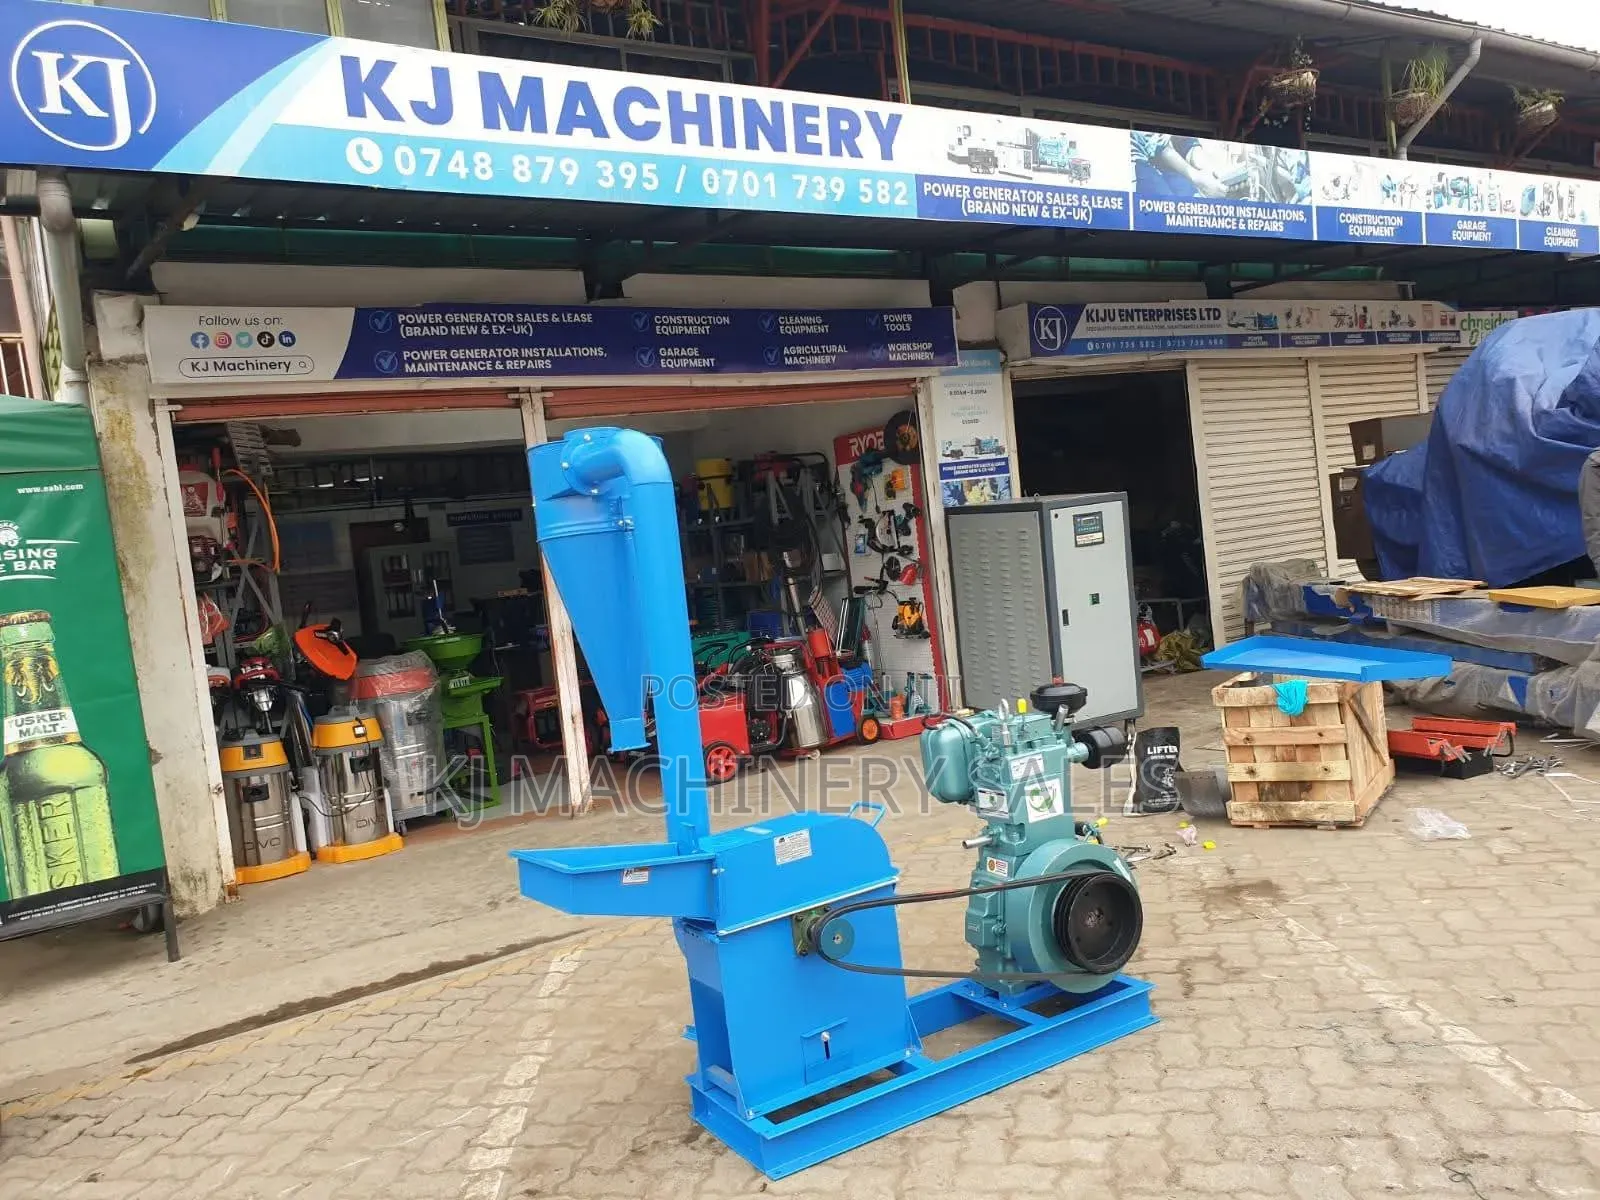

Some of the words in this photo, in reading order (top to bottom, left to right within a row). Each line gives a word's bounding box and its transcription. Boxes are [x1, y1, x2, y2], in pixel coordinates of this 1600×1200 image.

[31, 50, 131, 156] KJ
[340, 55, 454, 125] KJ
[478, 71, 903, 161] MACHINERY
[394, 145, 494, 181] 0748
[512, 154, 580, 186] 879
[596, 159, 660, 192] 395
[674, 164, 687, 194] /
[702, 167, 777, 199] 0701
[792, 174, 845, 204] 739
[858, 178, 908, 206] 582
[923, 182, 971, 199] POWER
[973, 186, 1044, 204] GENERATOR
[1046, 193, 1079, 207] SALES
[1081, 196, 1091, 207] &
[1092, 196, 1124, 210] LEASE
[961, 196, 1010, 217] (BRAND
[1012, 204, 1039, 217] NEW
[1041, 206, 1050, 217] &
[1053, 205, 1093, 224] EX-UK)
[1139, 200, 1175, 213] POWER
[1179, 202, 1235, 217] GENERATOR
[1236, 206, 1307, 223] INSTALLATIONS,
[1166, 214, 1237, 230] MAINTENANCE
[1239, 220, 1246, 230] &
[1247, 219, 1284, 232] REPAIRS
[1339, 213, 1404, 226] CONSTRUCTION
[1456, 220, 1487, 231] GARAGE
[1349, 225, 1395, 237] EQUIPMENT
[1452, 230, 1492, 242] EQUIPMENT
[1545, 227, 1577, 238] CLEANING
[1544, 236, 1579, 248] EQUIPMENT
[199, 315, 241, 326] Follow
[245, 316, 260, 326] us
[264, 315, 284, 326] on:
[398, 313, 444, 325] POWER
[445, 313, 514, 323] GENERATOR
[516, 313, 549, 323] SALES
[551, 313, 561, 323] &
[562, 313, 593, 323] LEASE
[654, 315, 730, 326] CONSTRUCTION
[778, 315, 823, 326] CLEANING
[883, 313, 913, 323] POWER
[1085, 308, 1116, 323] KIJU
[1119, 307, 1198, 323] ENTERPRISES
[1199, 307, 1222, 321] LTD
[400, 324, 449, 338] (BRAND
[451, 325, 478, 336] NEW
[480, 325, 490, 335] &
[492, 323, 533, 337] EX-UK)
[656, 325, 711, 335] EQUIPMENT
[780, 325, 829, 334] EQUIPMENT
[885, 322, 911, 332] TOOLS
[1038, 317, 1062, 349] KJ
[659, 347, 700, 358] GARAGE
[783, 344, 848, 356] AGRICULTURAL
[887, 342, 933, 352] WORKSHOP
[403, 350, 448, 361] POWER
[450, 349, 519, 360] GENERATOR
[521, 347, 608, 359] INSTALLATIONS,
[888, 352, 935, 362] MACHINERY
[191, 361, 209, 372] KJ
[214, 359, 291, 373] Machinery
[404, 360, 493, 373] MAINTENANCE
[495, 360, 504, 370] &
[506, 360, 552, 370] REPAIRS
[660, 358, 716, 368] EQUIPMENT
[785, 355, 837, 366] MACHINERY
[0, 548, 58, 560] SING
[13, 559, 57, 571] BAR
[8, 711, 68, 728] TUSKER
[19, 723, 60, 738] MALT
